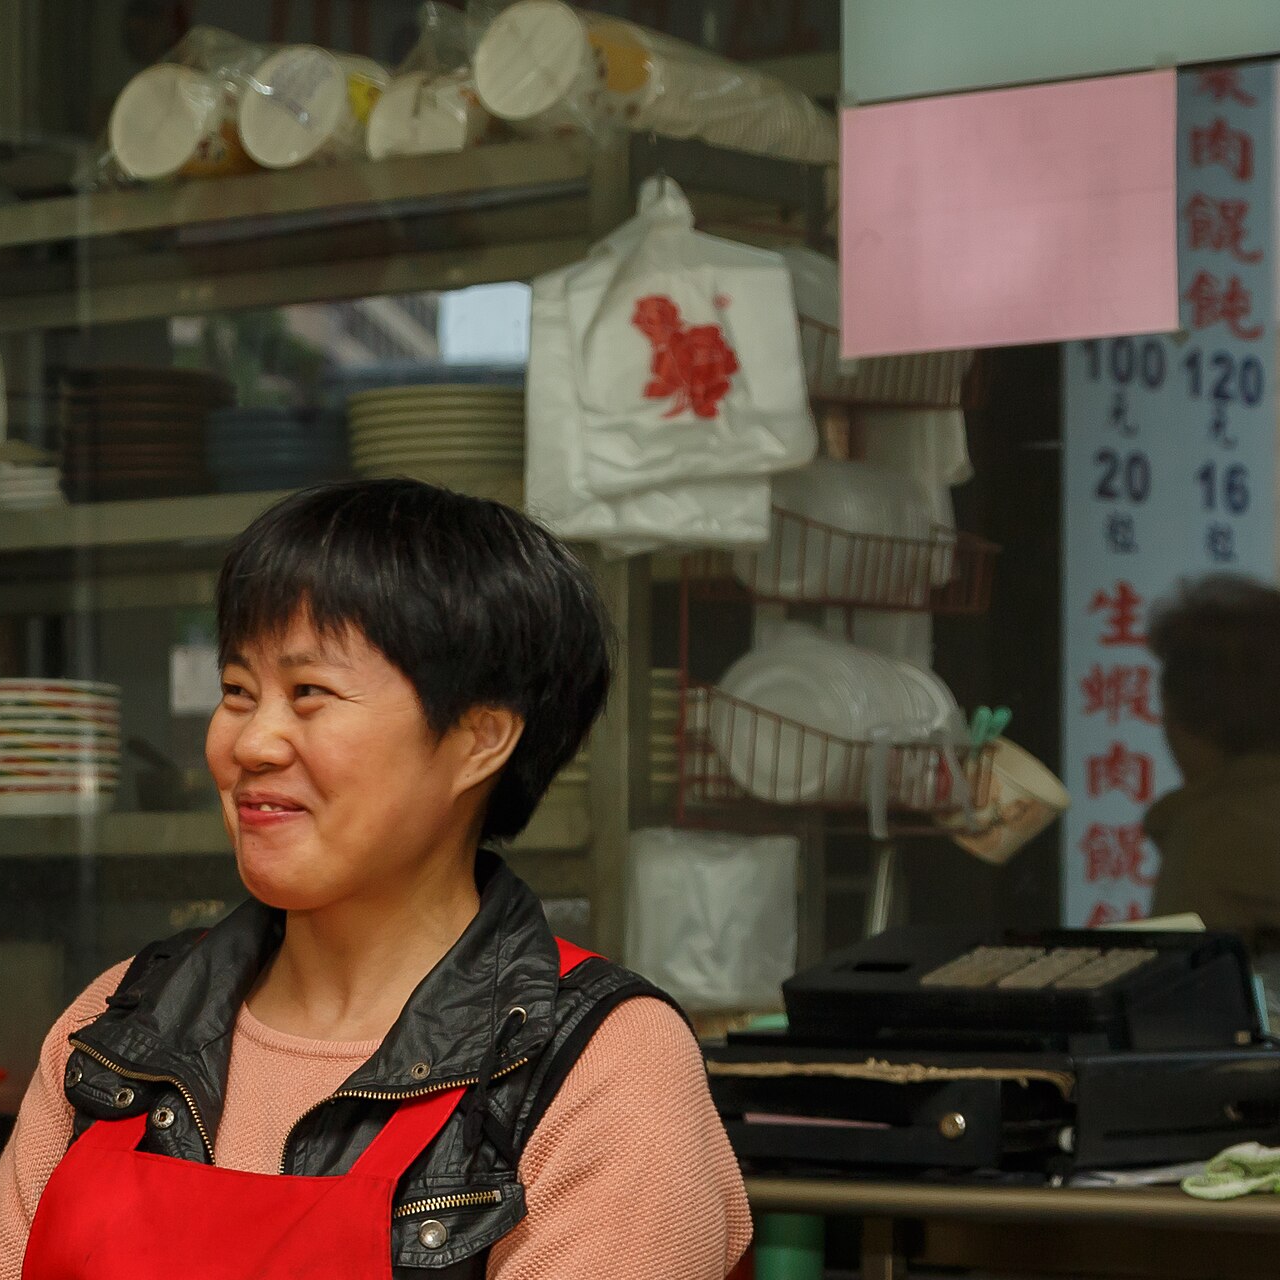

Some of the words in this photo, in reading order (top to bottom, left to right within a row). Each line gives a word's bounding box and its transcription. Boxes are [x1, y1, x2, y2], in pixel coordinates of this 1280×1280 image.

[1080, 339, 1167, 391] 100
[1183, 347, 1266, 408] 120
[1095, 446, 1153, 505] 20
[1196, 459, 1252, 516] 16
